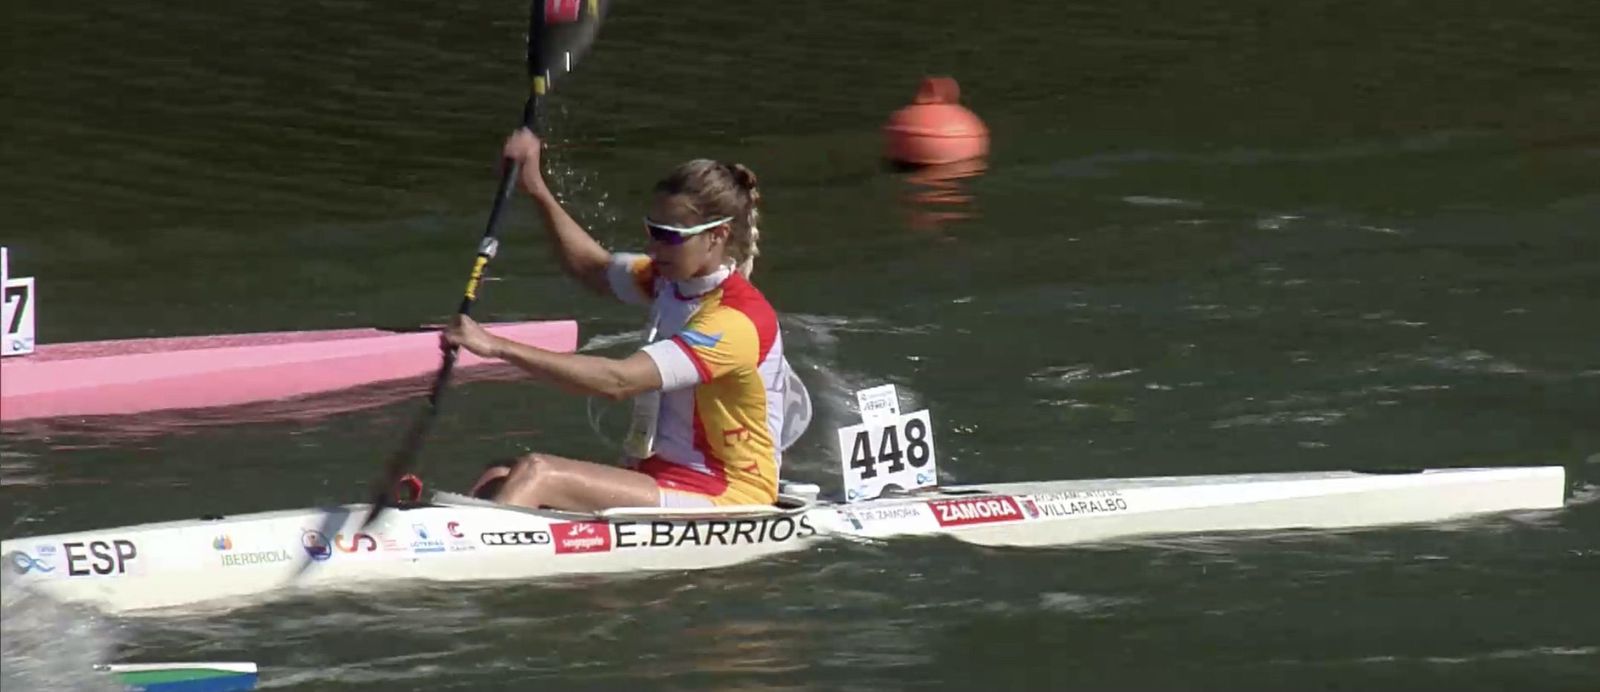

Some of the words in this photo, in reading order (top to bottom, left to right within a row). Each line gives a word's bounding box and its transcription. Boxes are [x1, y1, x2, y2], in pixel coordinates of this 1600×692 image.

[5, 285, 28, 334] 7
[850, 418, 930, 479] 448
[936, 500, 1017, 521] ZAMORA
[1038, 498, 1128, 516] VILLARALBO
[614, 515, 817, 548] E.BARRIOS
[63, 539, 137, 577] ESP
[221, 549, 292, 567] IBERDROLA
